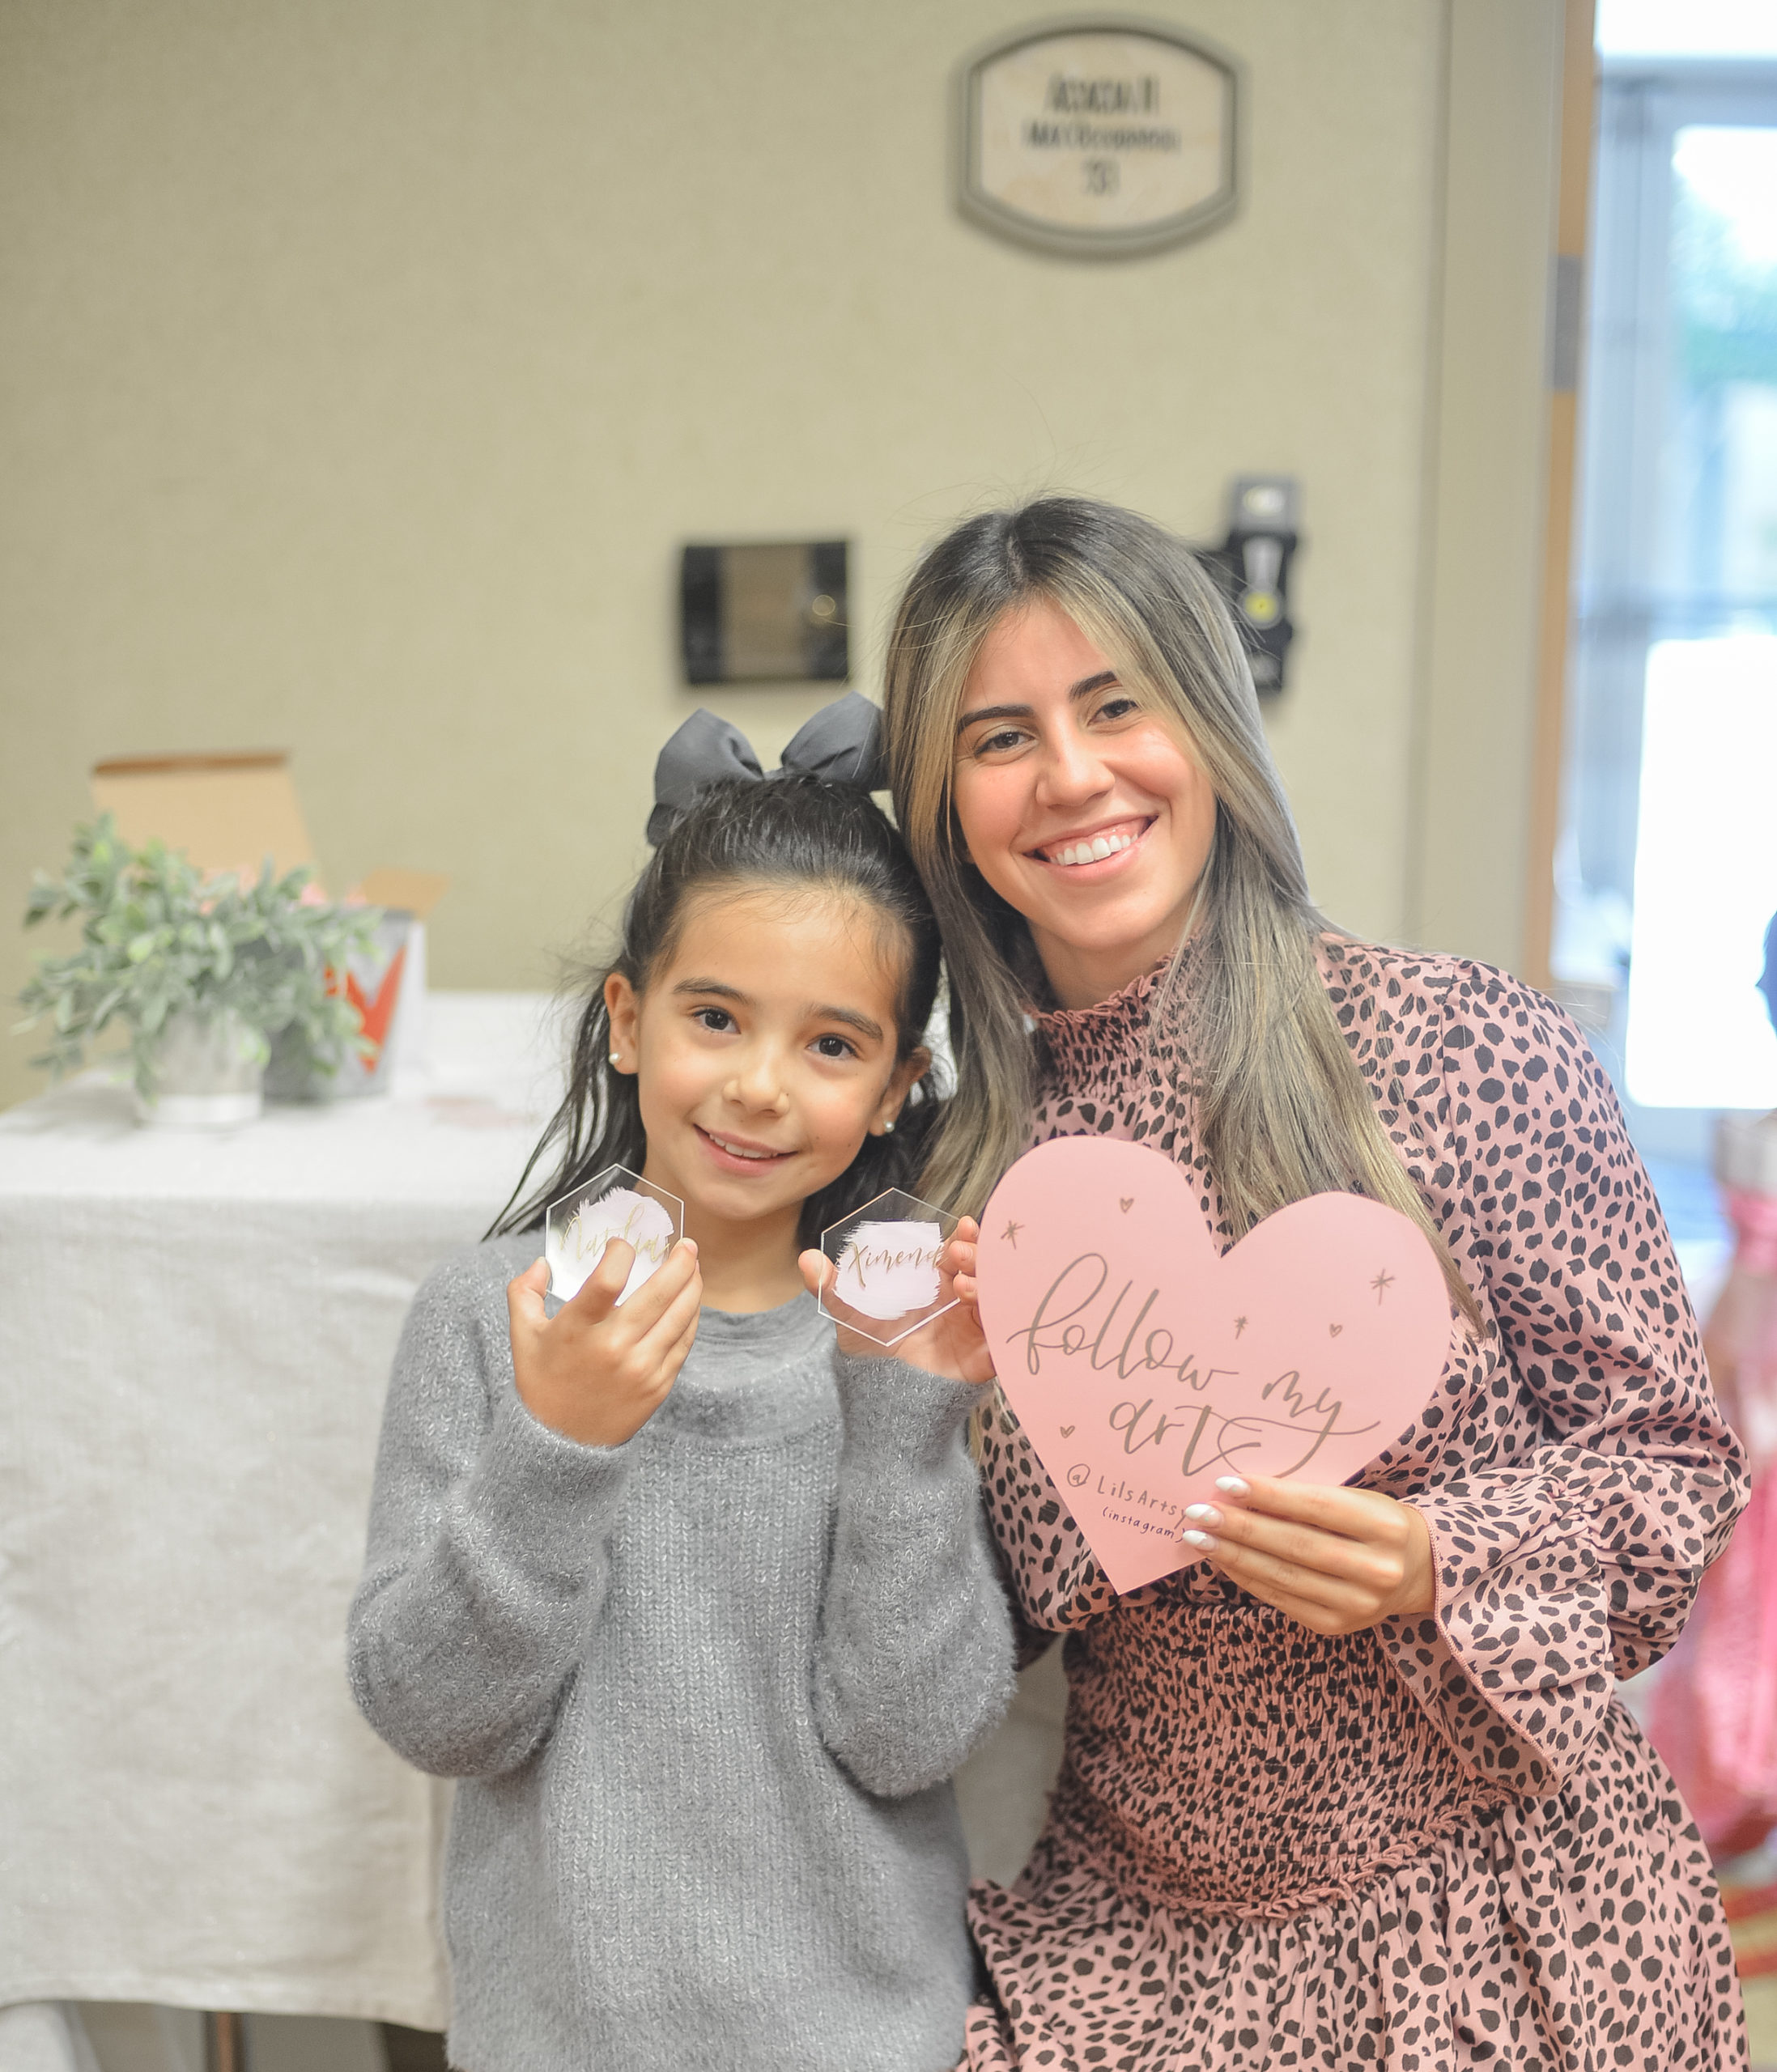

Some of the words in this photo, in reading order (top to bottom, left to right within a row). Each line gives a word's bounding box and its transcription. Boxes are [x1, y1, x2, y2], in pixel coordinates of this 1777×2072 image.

[1006, 1253, 1239, 1390] follow
[1218, 1371, 1381, 1479] my
[1109, 1399, 1262, 1476] art
